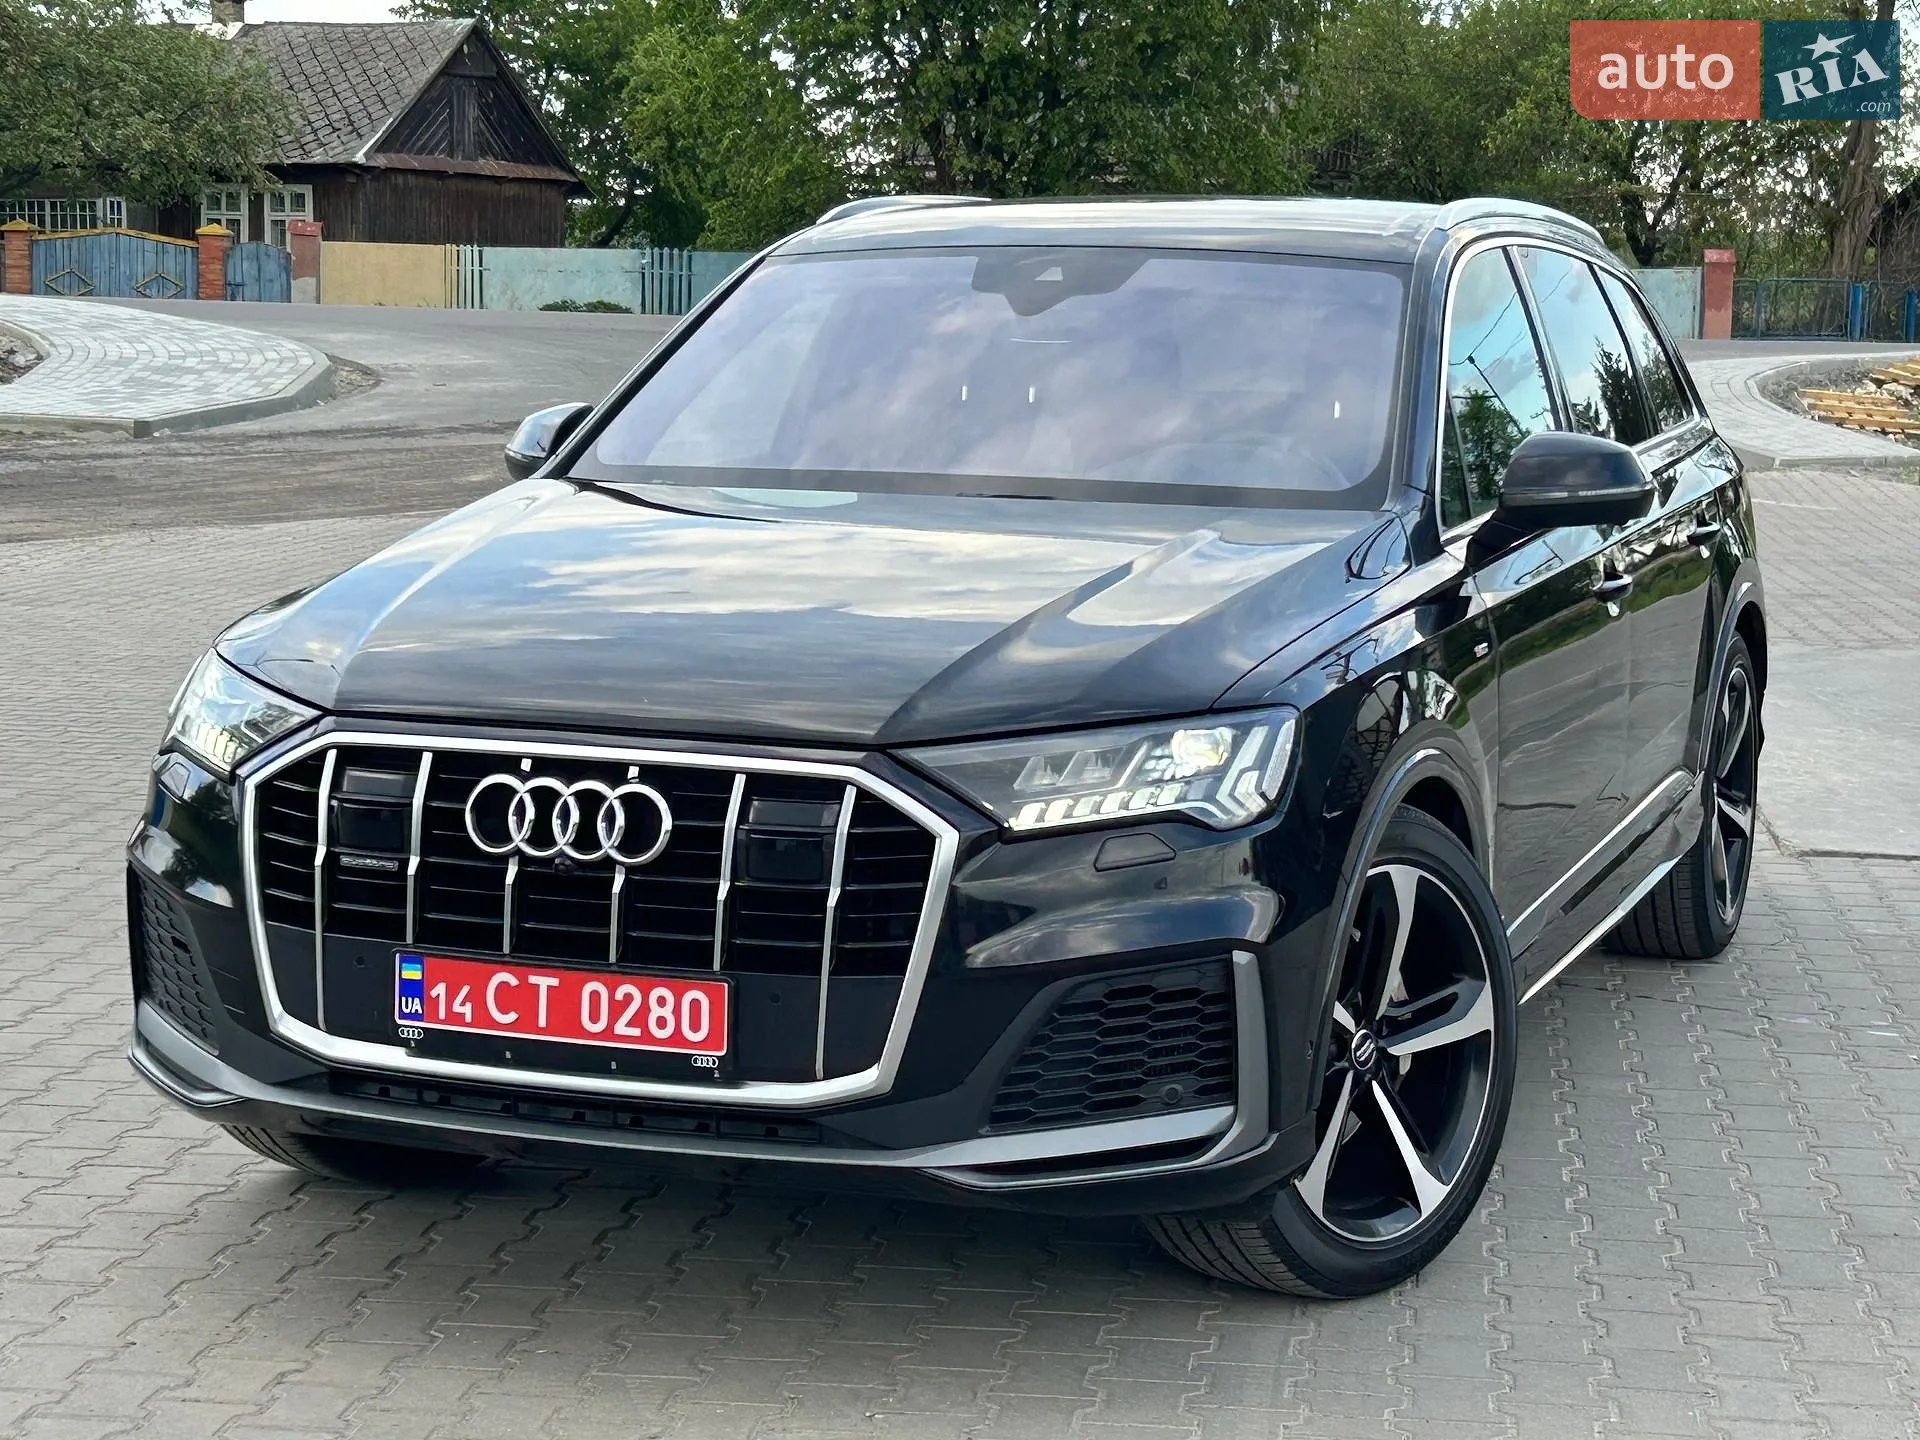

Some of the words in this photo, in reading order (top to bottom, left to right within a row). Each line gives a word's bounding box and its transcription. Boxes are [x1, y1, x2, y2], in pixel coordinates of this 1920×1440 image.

[401, 997, 423, 1014] UA
[429, 982, 473, 1023] 14
[486, 971, 560, 1028] CT
[580, 981, 710, 1042] 0280
